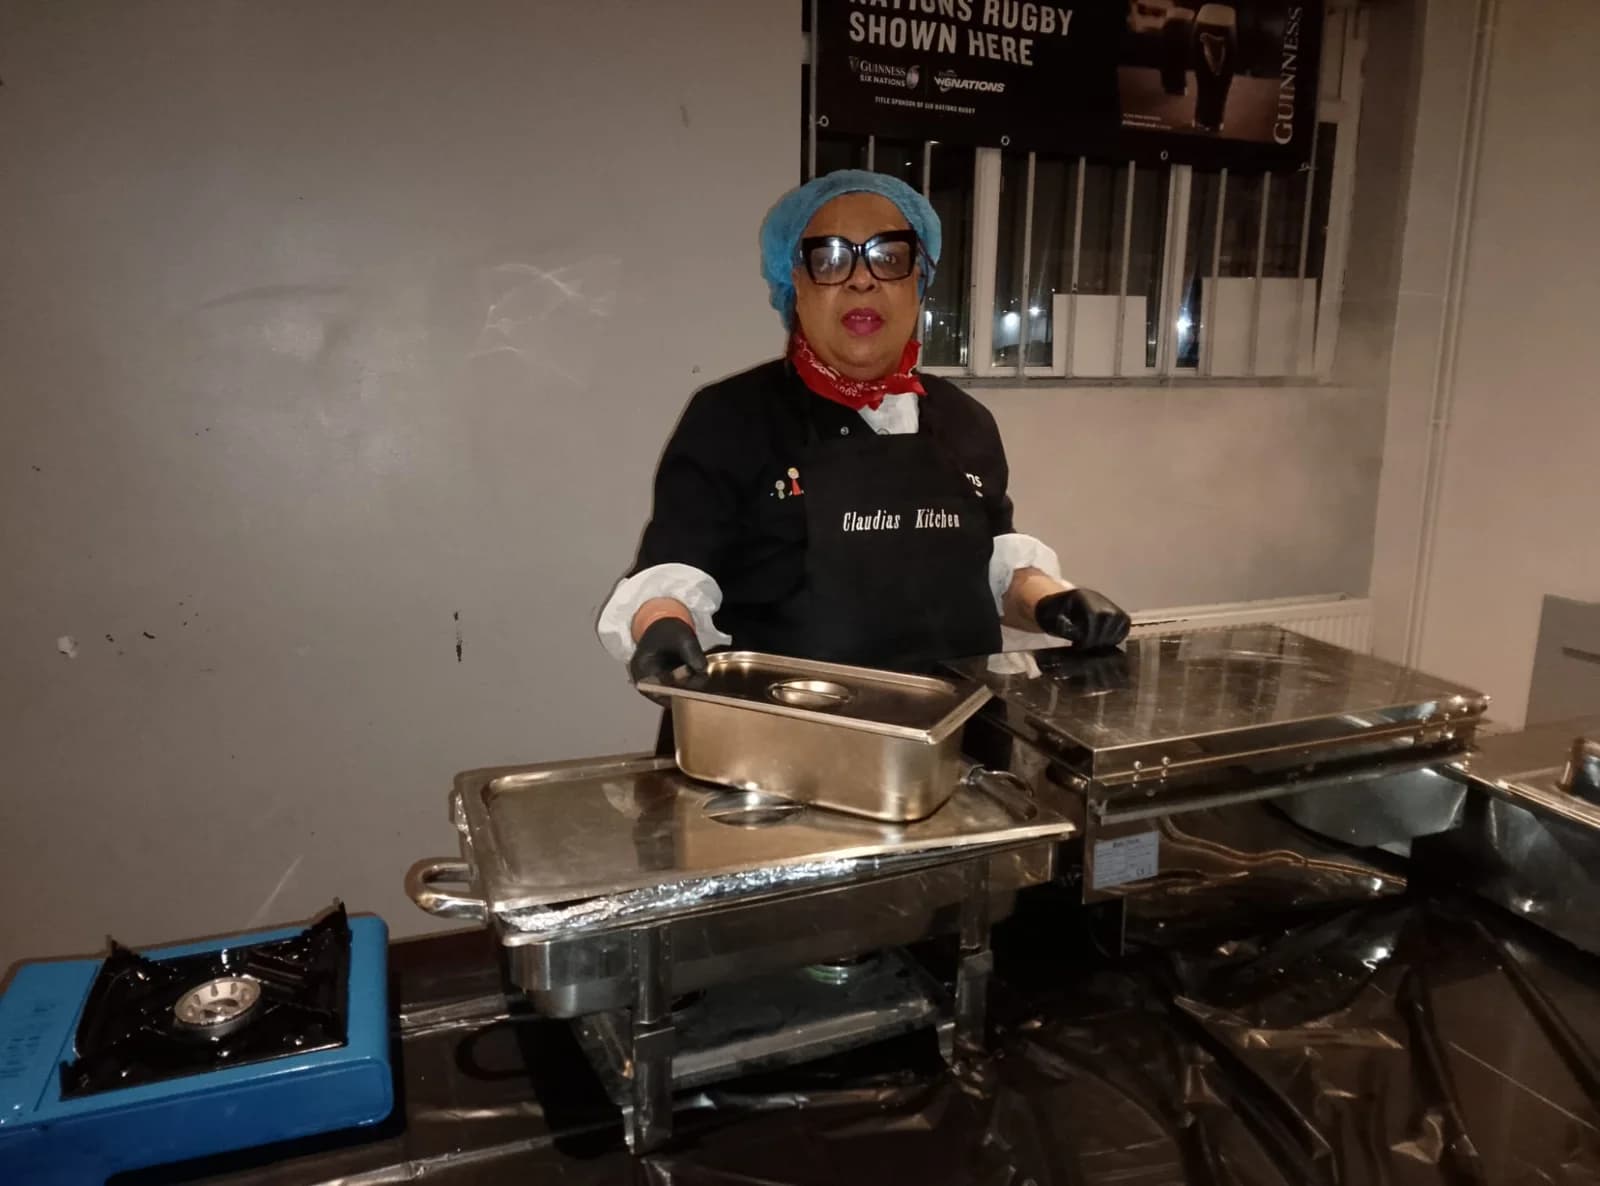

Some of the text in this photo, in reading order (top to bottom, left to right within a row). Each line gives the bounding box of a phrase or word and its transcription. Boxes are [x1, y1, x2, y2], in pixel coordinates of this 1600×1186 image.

[983, 0, 1073, 36] RUGBY
[849, 11, 957, 54] SHOWN
[968, 29, 1034, 66] HERE
[860, 59, 906, 77] GUINNESS
[1273, 7, 1303, 145] GUINNESS
[873, 76, 906, 88] NATIONS
[965, 472, 983, 488] ns
[843, 508, 960, 532] Claudias Kitchen
